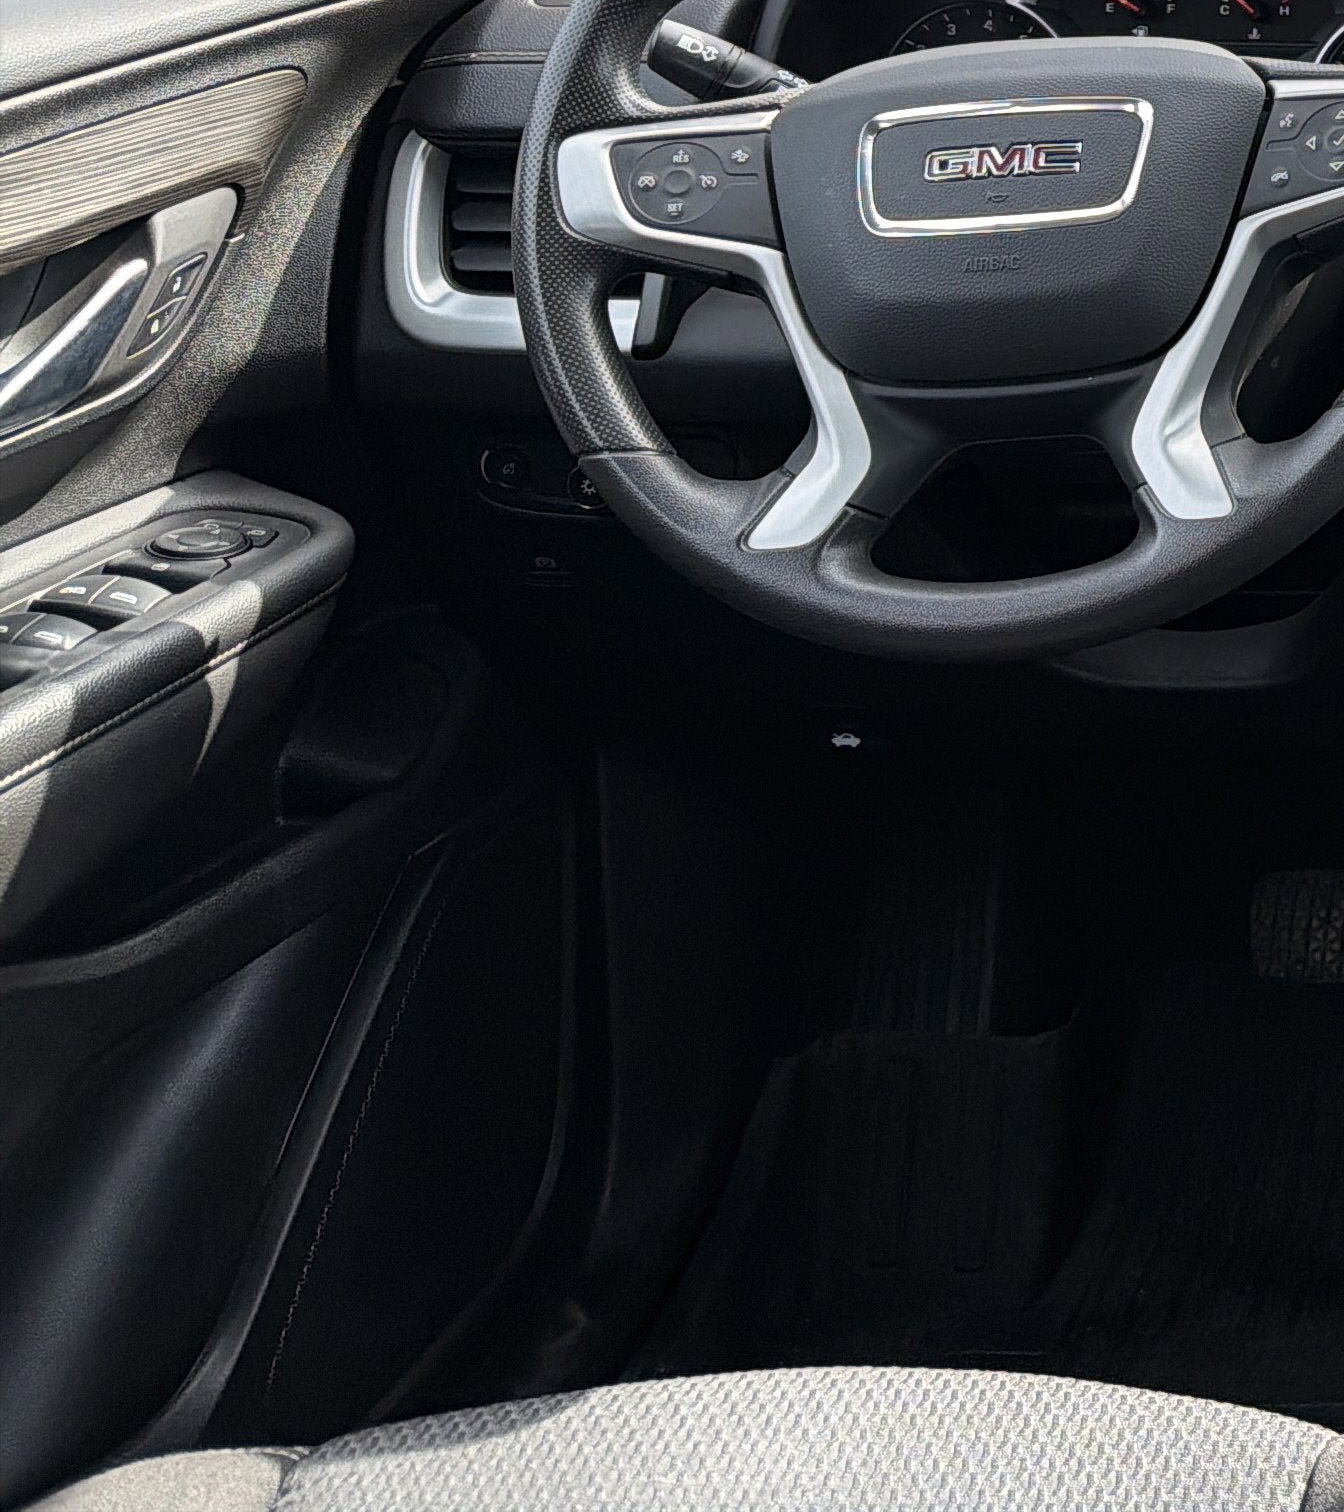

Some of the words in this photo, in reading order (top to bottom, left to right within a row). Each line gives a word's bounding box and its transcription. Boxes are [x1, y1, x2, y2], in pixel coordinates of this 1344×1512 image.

[1104, 2, 1115, 14] E
[1166, 3, 1176, 15] F
[1219, 4, 1231, 16] C
[1279, 5, 1290, 17] H
[947, 23, 957, 36] 3
[983, 19, 993, 32] 4
[672, 154, 690, 164] RES
[924, 141, 1083, 183] GMC
[667, 202, 684, 212] SET
[964, 254, 1021, 273] AIRBAG
